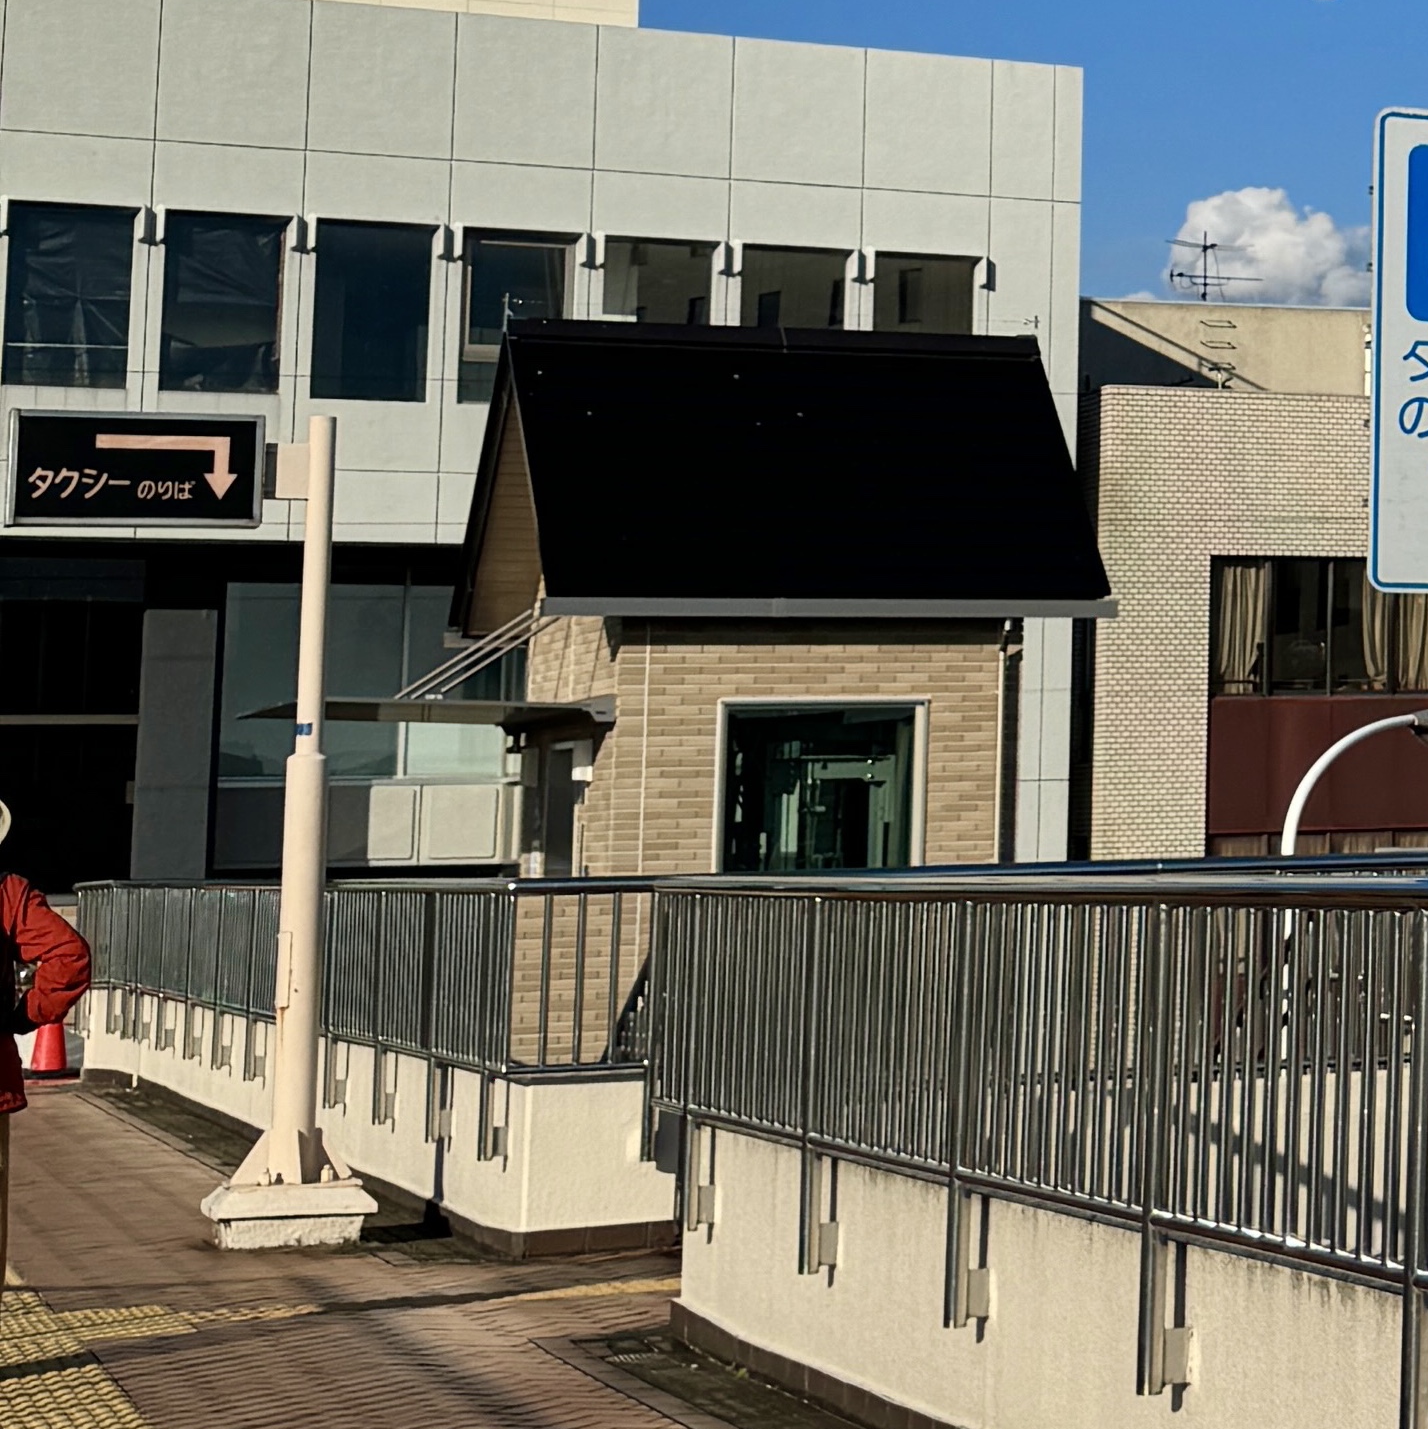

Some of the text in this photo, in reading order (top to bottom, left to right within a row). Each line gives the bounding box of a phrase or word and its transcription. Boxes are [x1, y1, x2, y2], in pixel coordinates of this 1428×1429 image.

[27, 466, 196, 501] タクシー のりば
